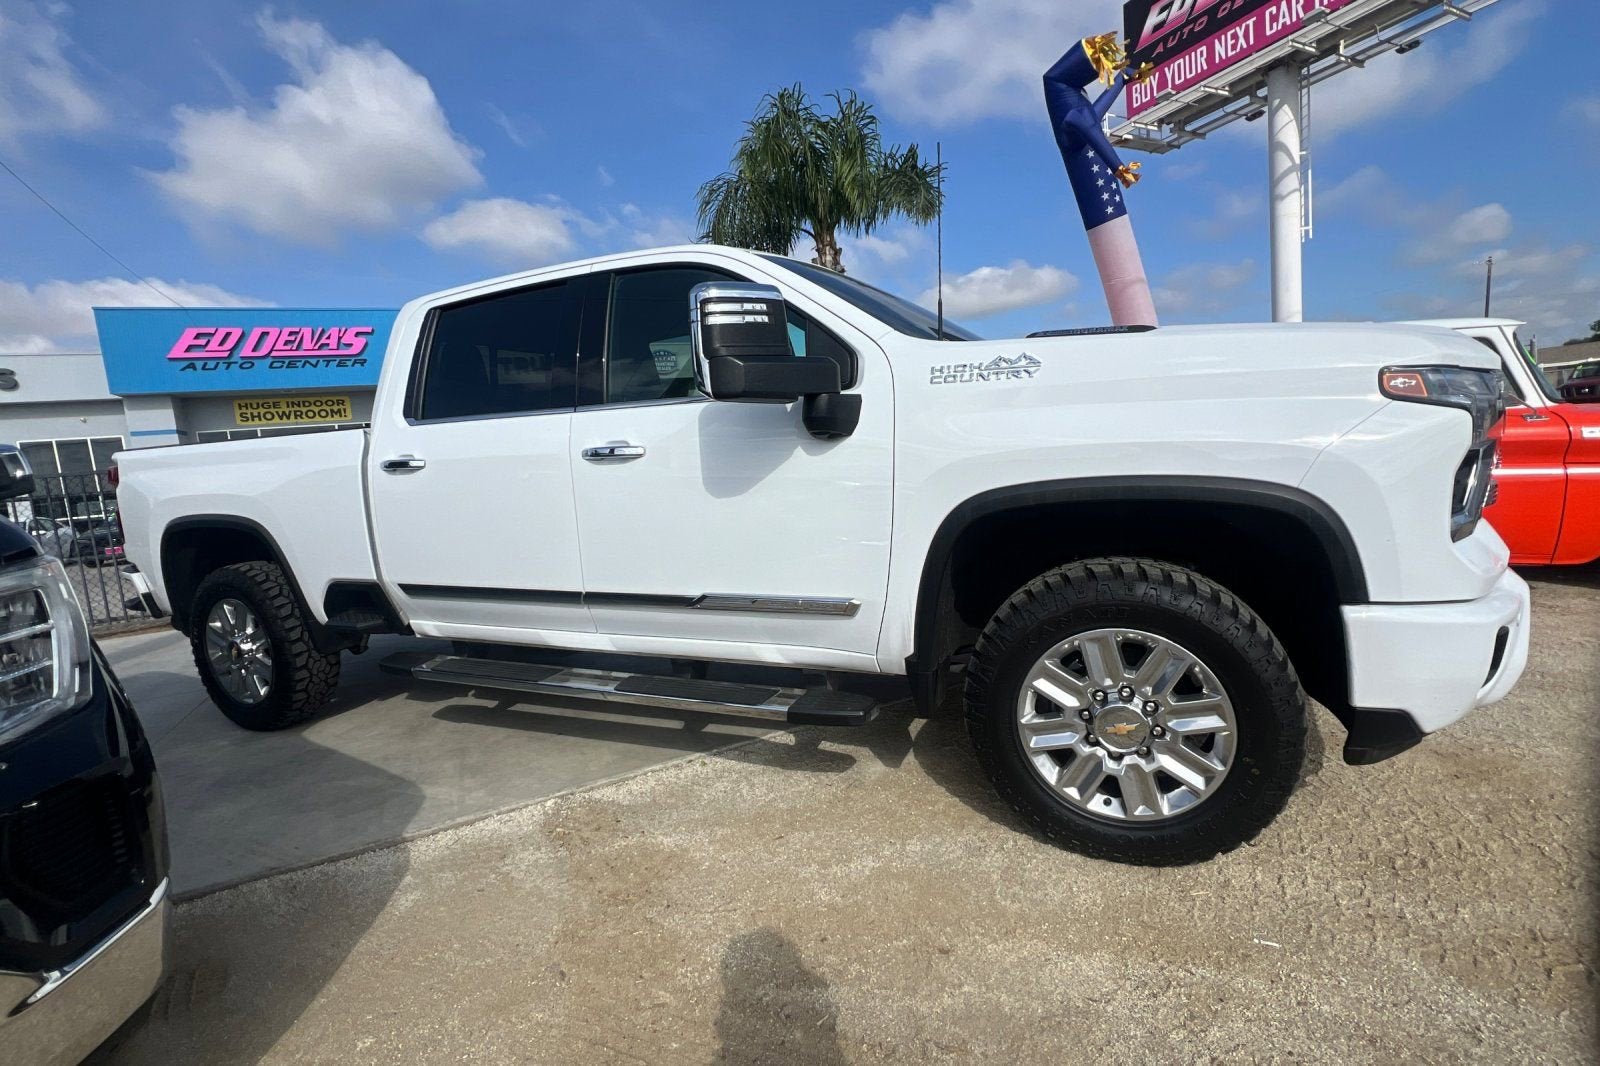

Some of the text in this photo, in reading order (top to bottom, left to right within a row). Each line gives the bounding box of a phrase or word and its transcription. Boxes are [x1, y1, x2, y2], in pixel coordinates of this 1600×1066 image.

[1151, 15, 1208, 57] AUTO
[1132, 72, 1159, 108] BUY
[1164, 45, 1208, 90] YOUR
[1214, 16, 1257, 64] NEXT
[1265, 0, 1305, 36] CAR
[166, 327, 373, 359] ED DENA'S
[179, 358, 368, 372] AUTO CENTER
[930, 362, 984, 376] HIGH
[929, 368, 1041, 385] COUNTRY
[237, 398, 346, 411] HUGE INDOOR
[239, 407, 348, 422] SHOWROOM!
